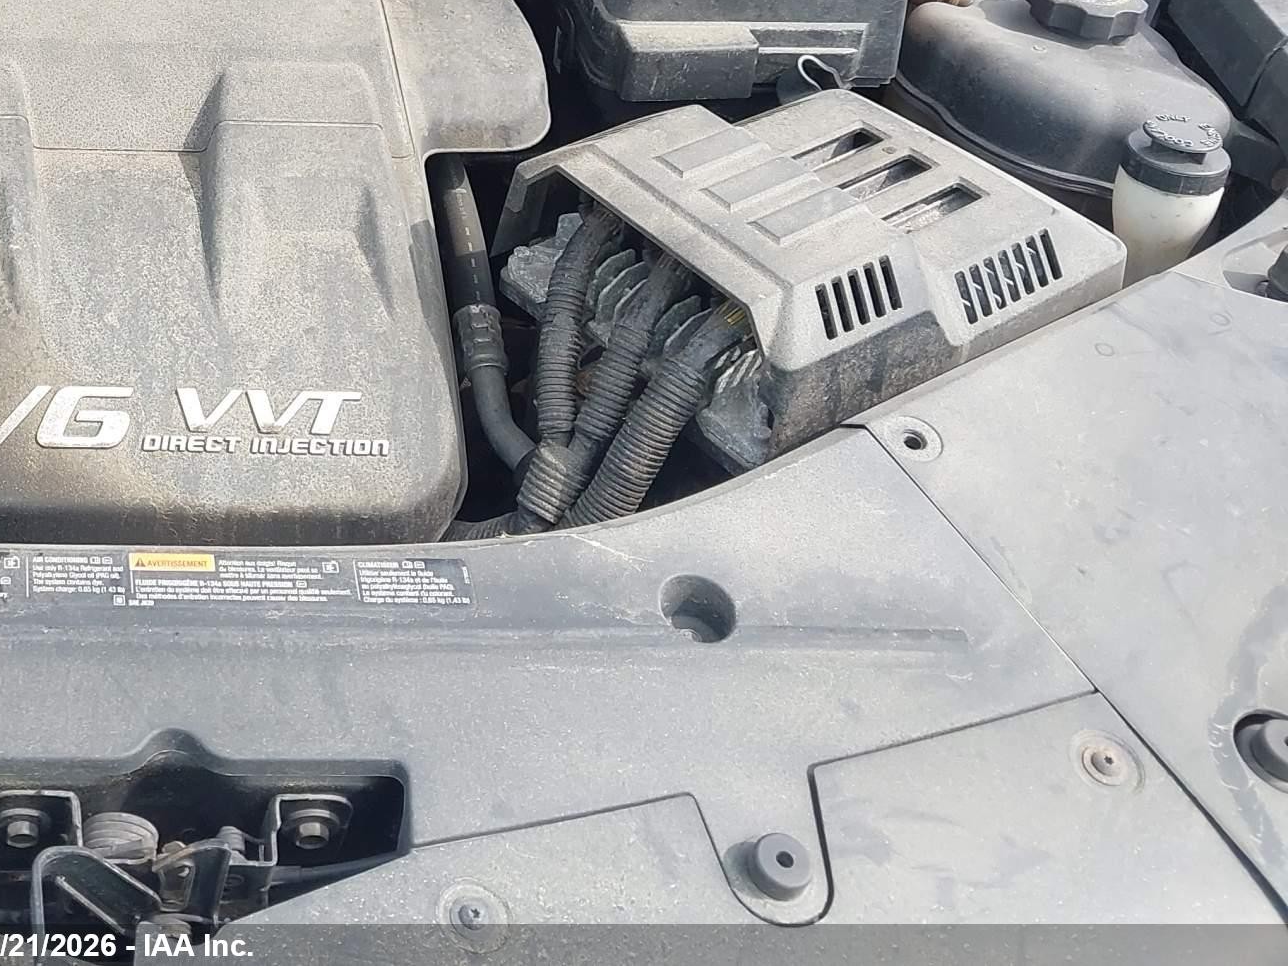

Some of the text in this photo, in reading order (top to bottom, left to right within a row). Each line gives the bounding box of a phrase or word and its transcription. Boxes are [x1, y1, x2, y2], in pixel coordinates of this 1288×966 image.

[175, 388, 362, 435] VVT
[141, 434, 390, 456] DIRECT INJECTION
[147, 560, 209, 568] AVERTISSEMENT
